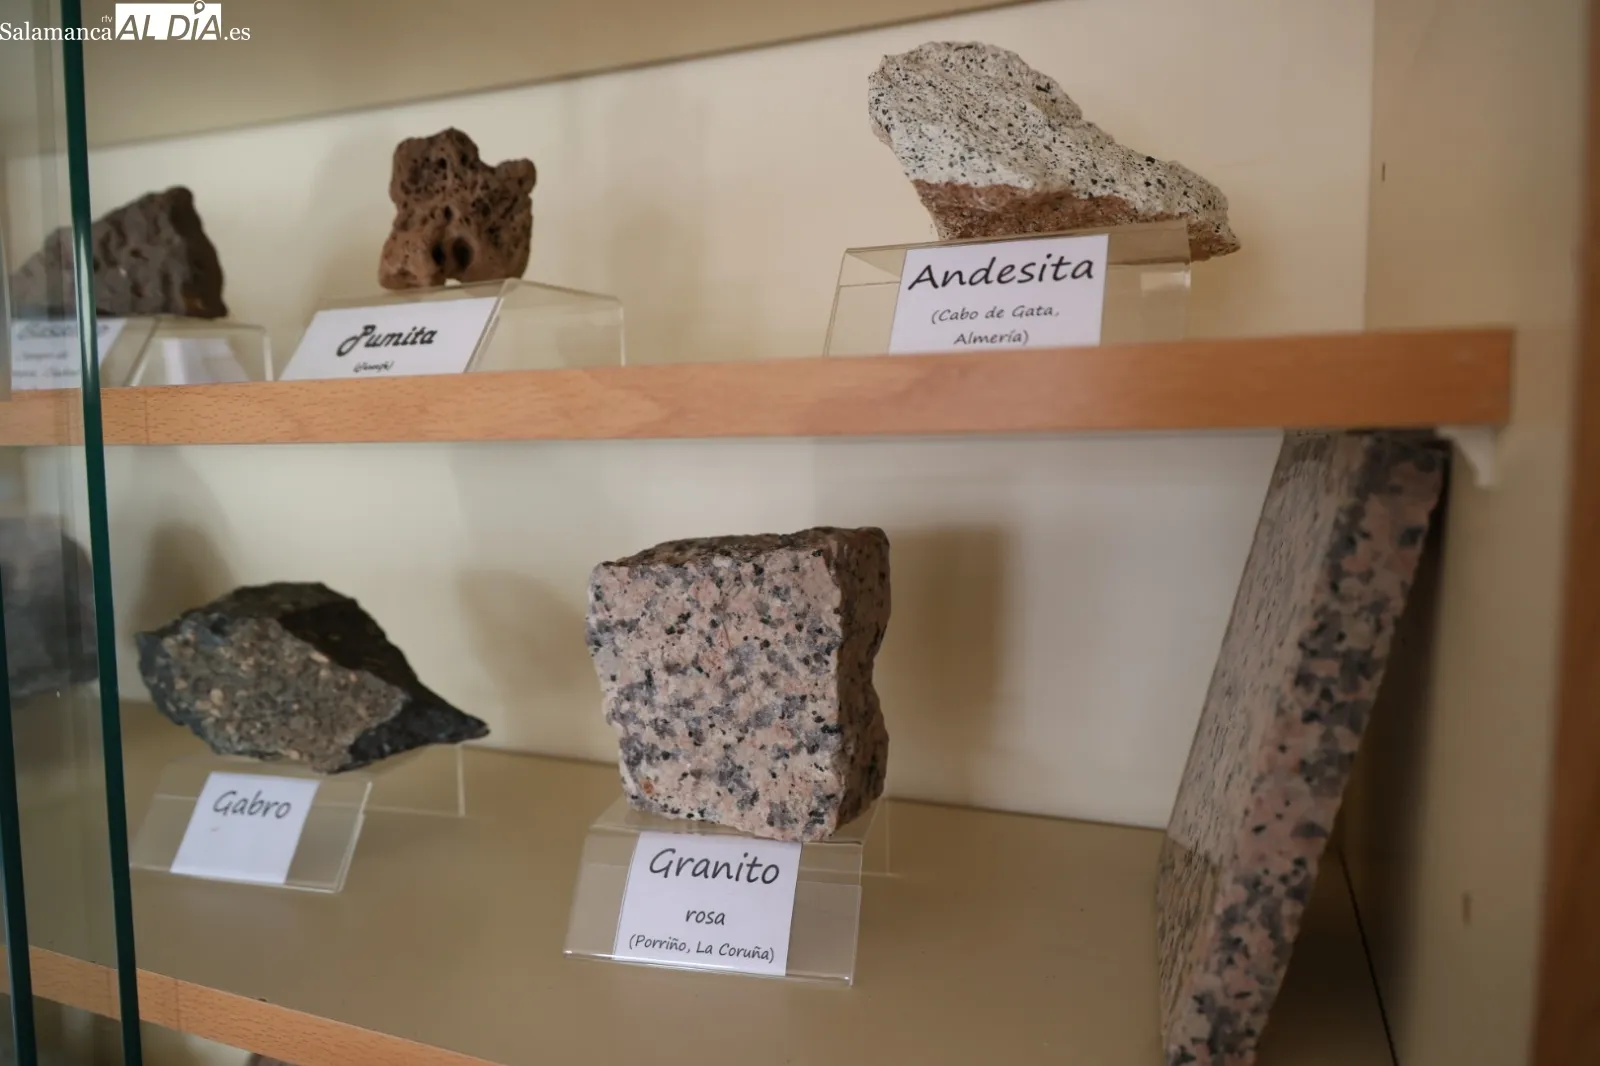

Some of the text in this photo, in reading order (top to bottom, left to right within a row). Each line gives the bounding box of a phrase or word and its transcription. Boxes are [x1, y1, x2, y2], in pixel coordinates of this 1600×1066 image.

[908, 253, 1095, 290] Andesita
[931, 304, 1060, 325] (Cabo de Gata,
[336, 324, 438, 357] Pumita
[953, 330, 1029, 346] Almería)
[212, 789, 292, 819] Gabro
[649, 848, 780, 885] Granito
[685, 909, 726, 926] rosa
[629, 933, 775, 964] (Porriño, La Coruña)
